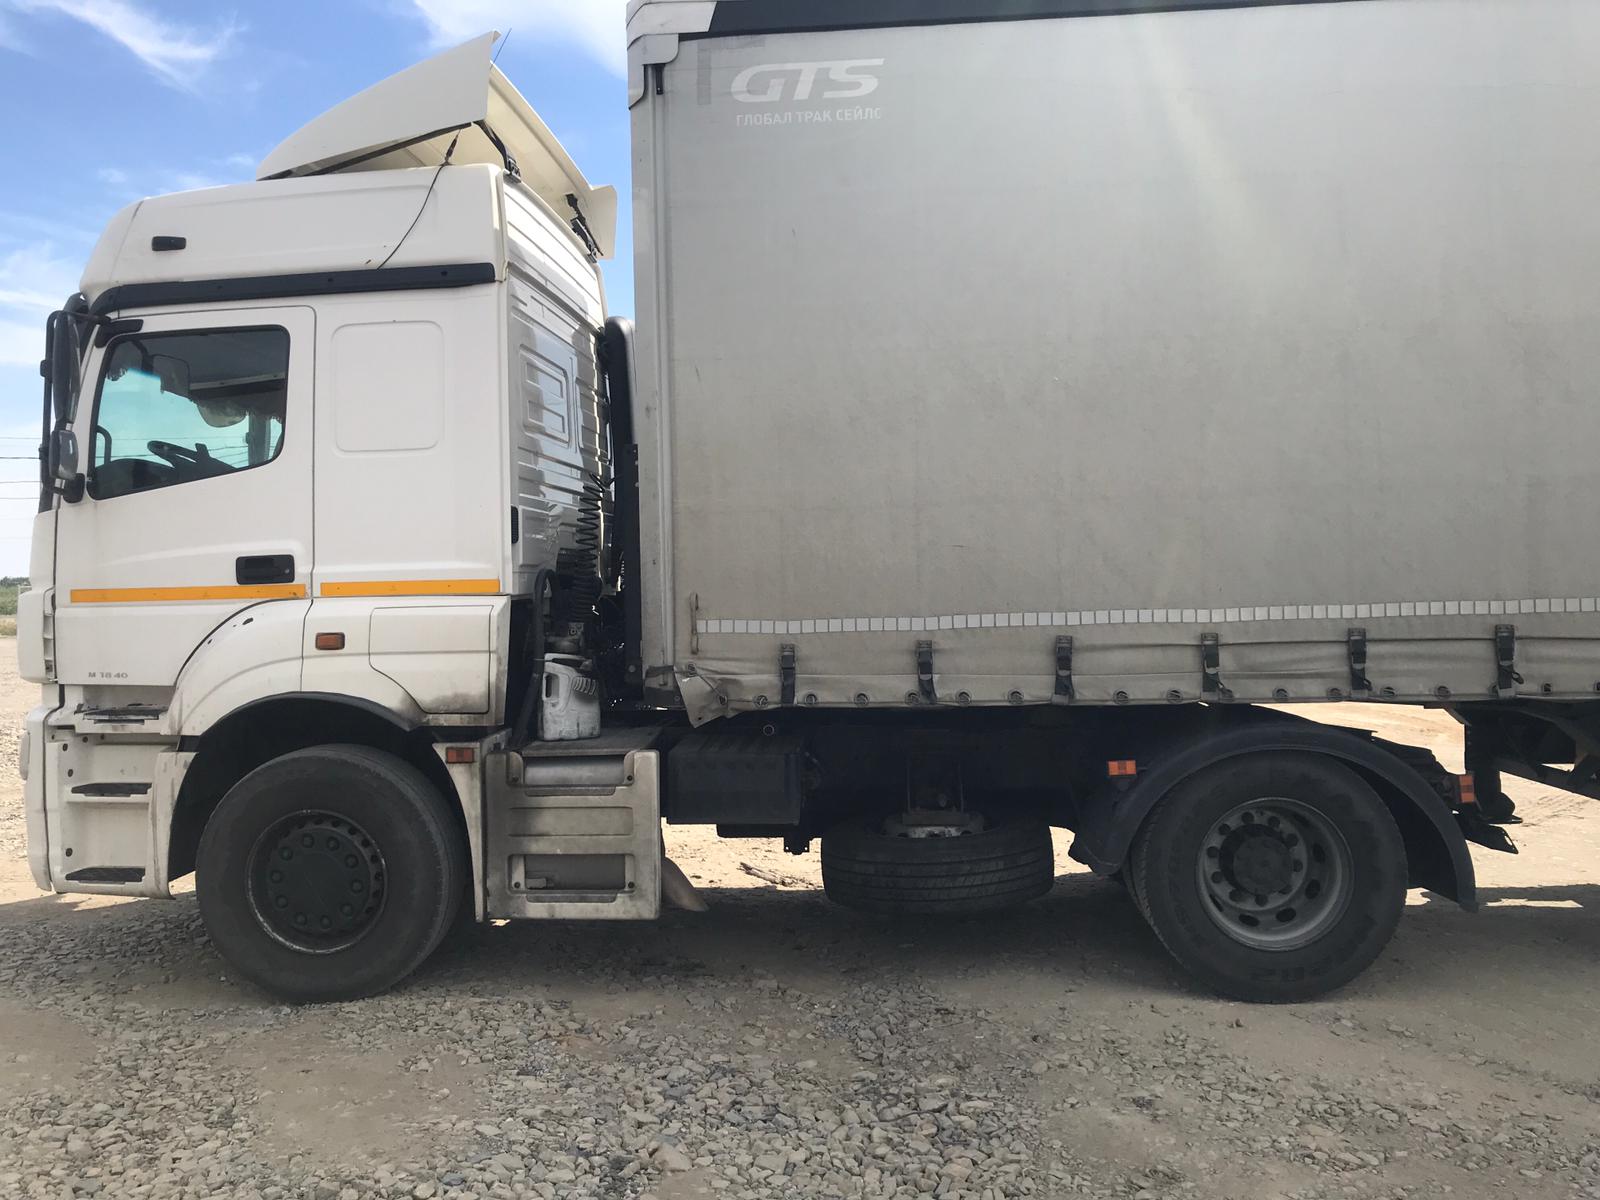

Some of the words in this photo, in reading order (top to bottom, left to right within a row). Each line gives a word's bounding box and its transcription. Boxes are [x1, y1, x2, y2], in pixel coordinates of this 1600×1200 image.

[730, 58, 885, 103] GTS
[736, 112, 792, 127] ГЛОБАЛ
[796, 110, 833, 123] ТРАК
[836, 106, 881, 121] СЕЙЛС
